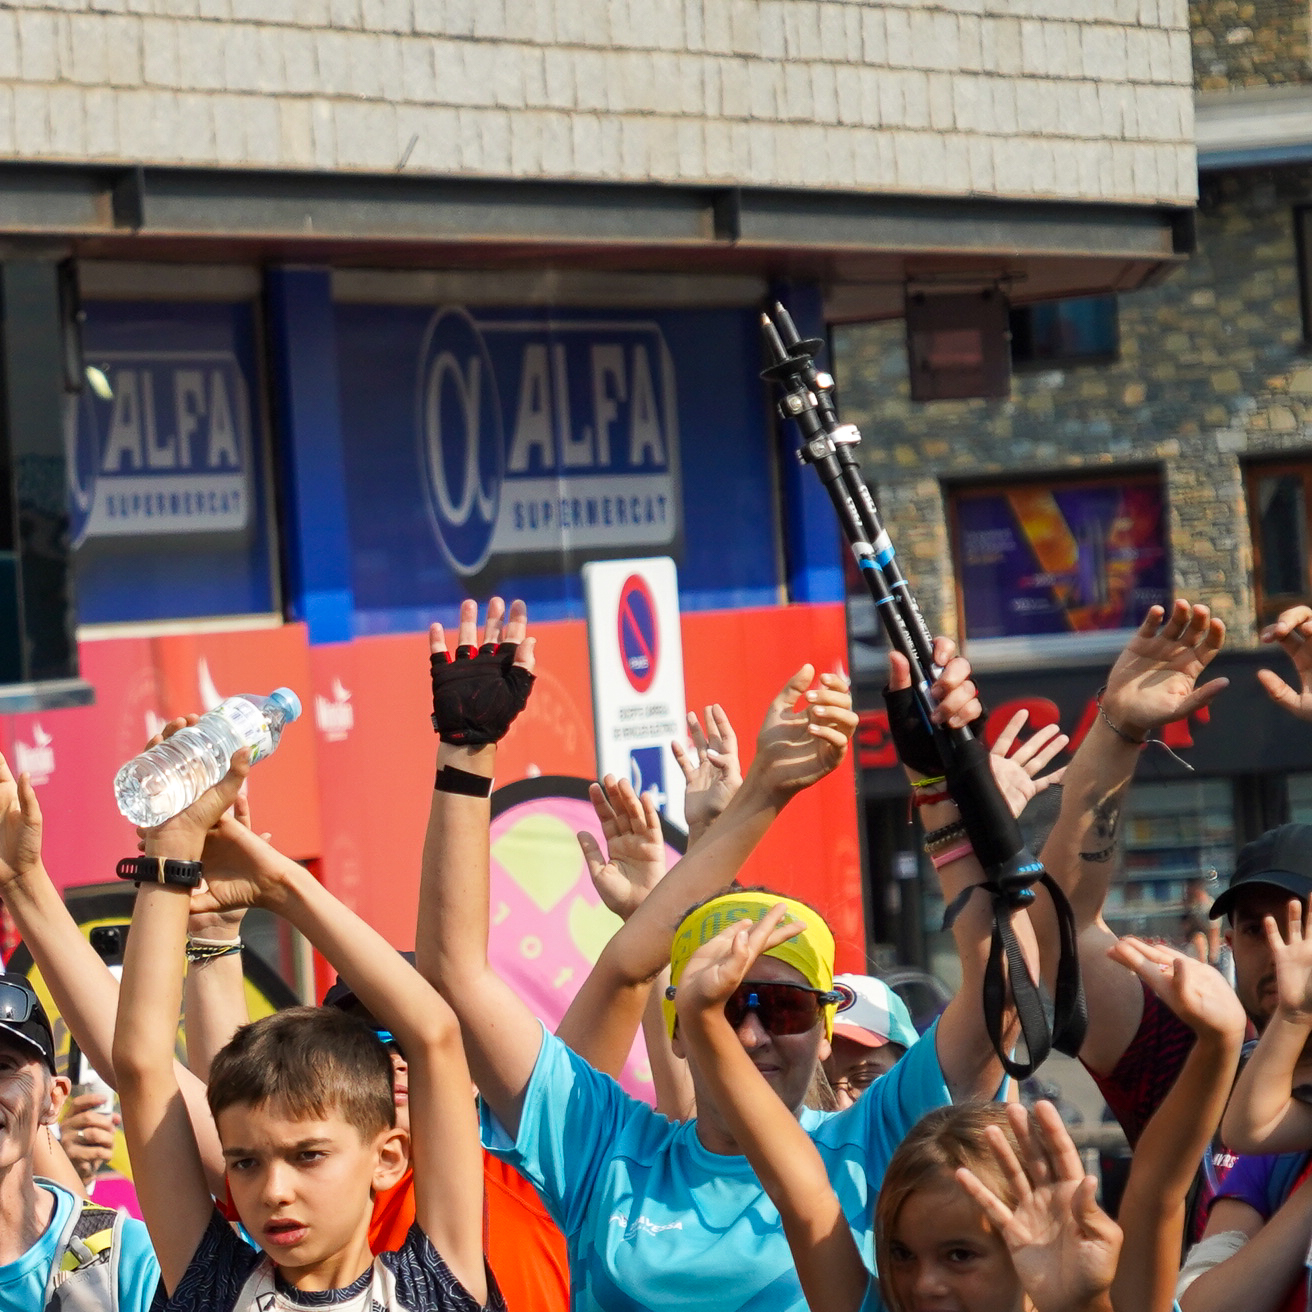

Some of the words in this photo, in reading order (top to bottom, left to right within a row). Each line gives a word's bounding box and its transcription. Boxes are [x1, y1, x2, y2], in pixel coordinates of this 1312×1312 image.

[102, 369, 240, 470] ALFA
[509, 344, 664, 472] ALFA
[105, 489, 241, 519] SUPERMERCAT
[512, 497, 667, 530] SUPERMERCAT
